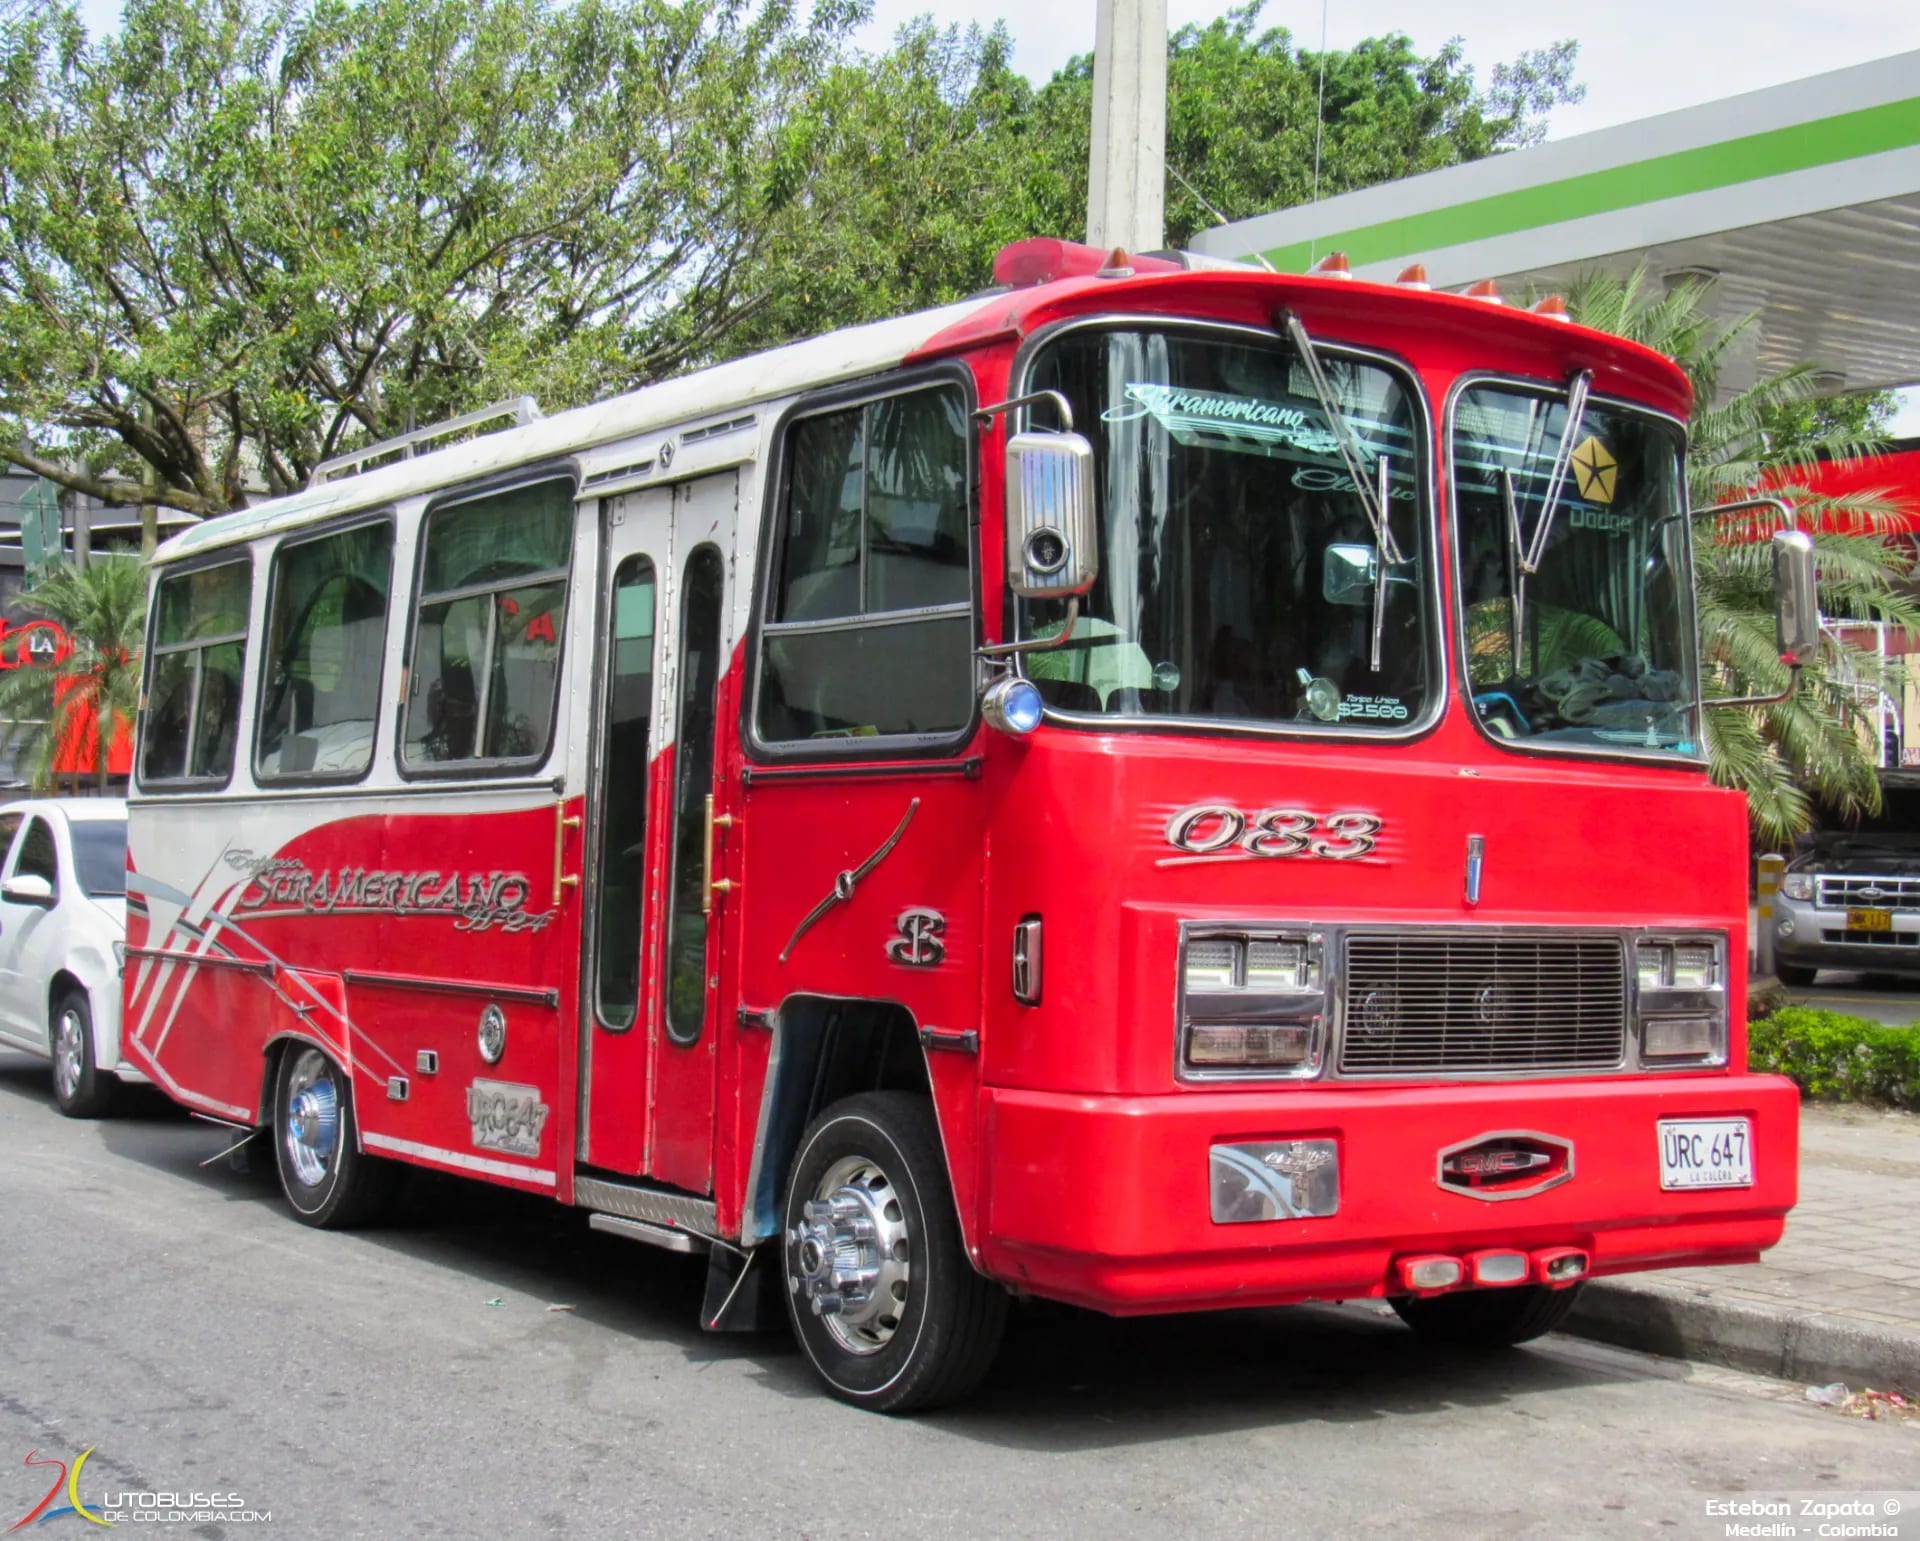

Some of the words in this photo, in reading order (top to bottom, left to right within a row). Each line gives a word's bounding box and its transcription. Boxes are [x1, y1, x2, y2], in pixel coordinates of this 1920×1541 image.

[1165, 803, 1383, 859] 083
[1460, 1152, 1517, 1173] GMC
[1664, 1134, 1704, 1168] URC
[1711, 1132, 1745, 1167] 647
